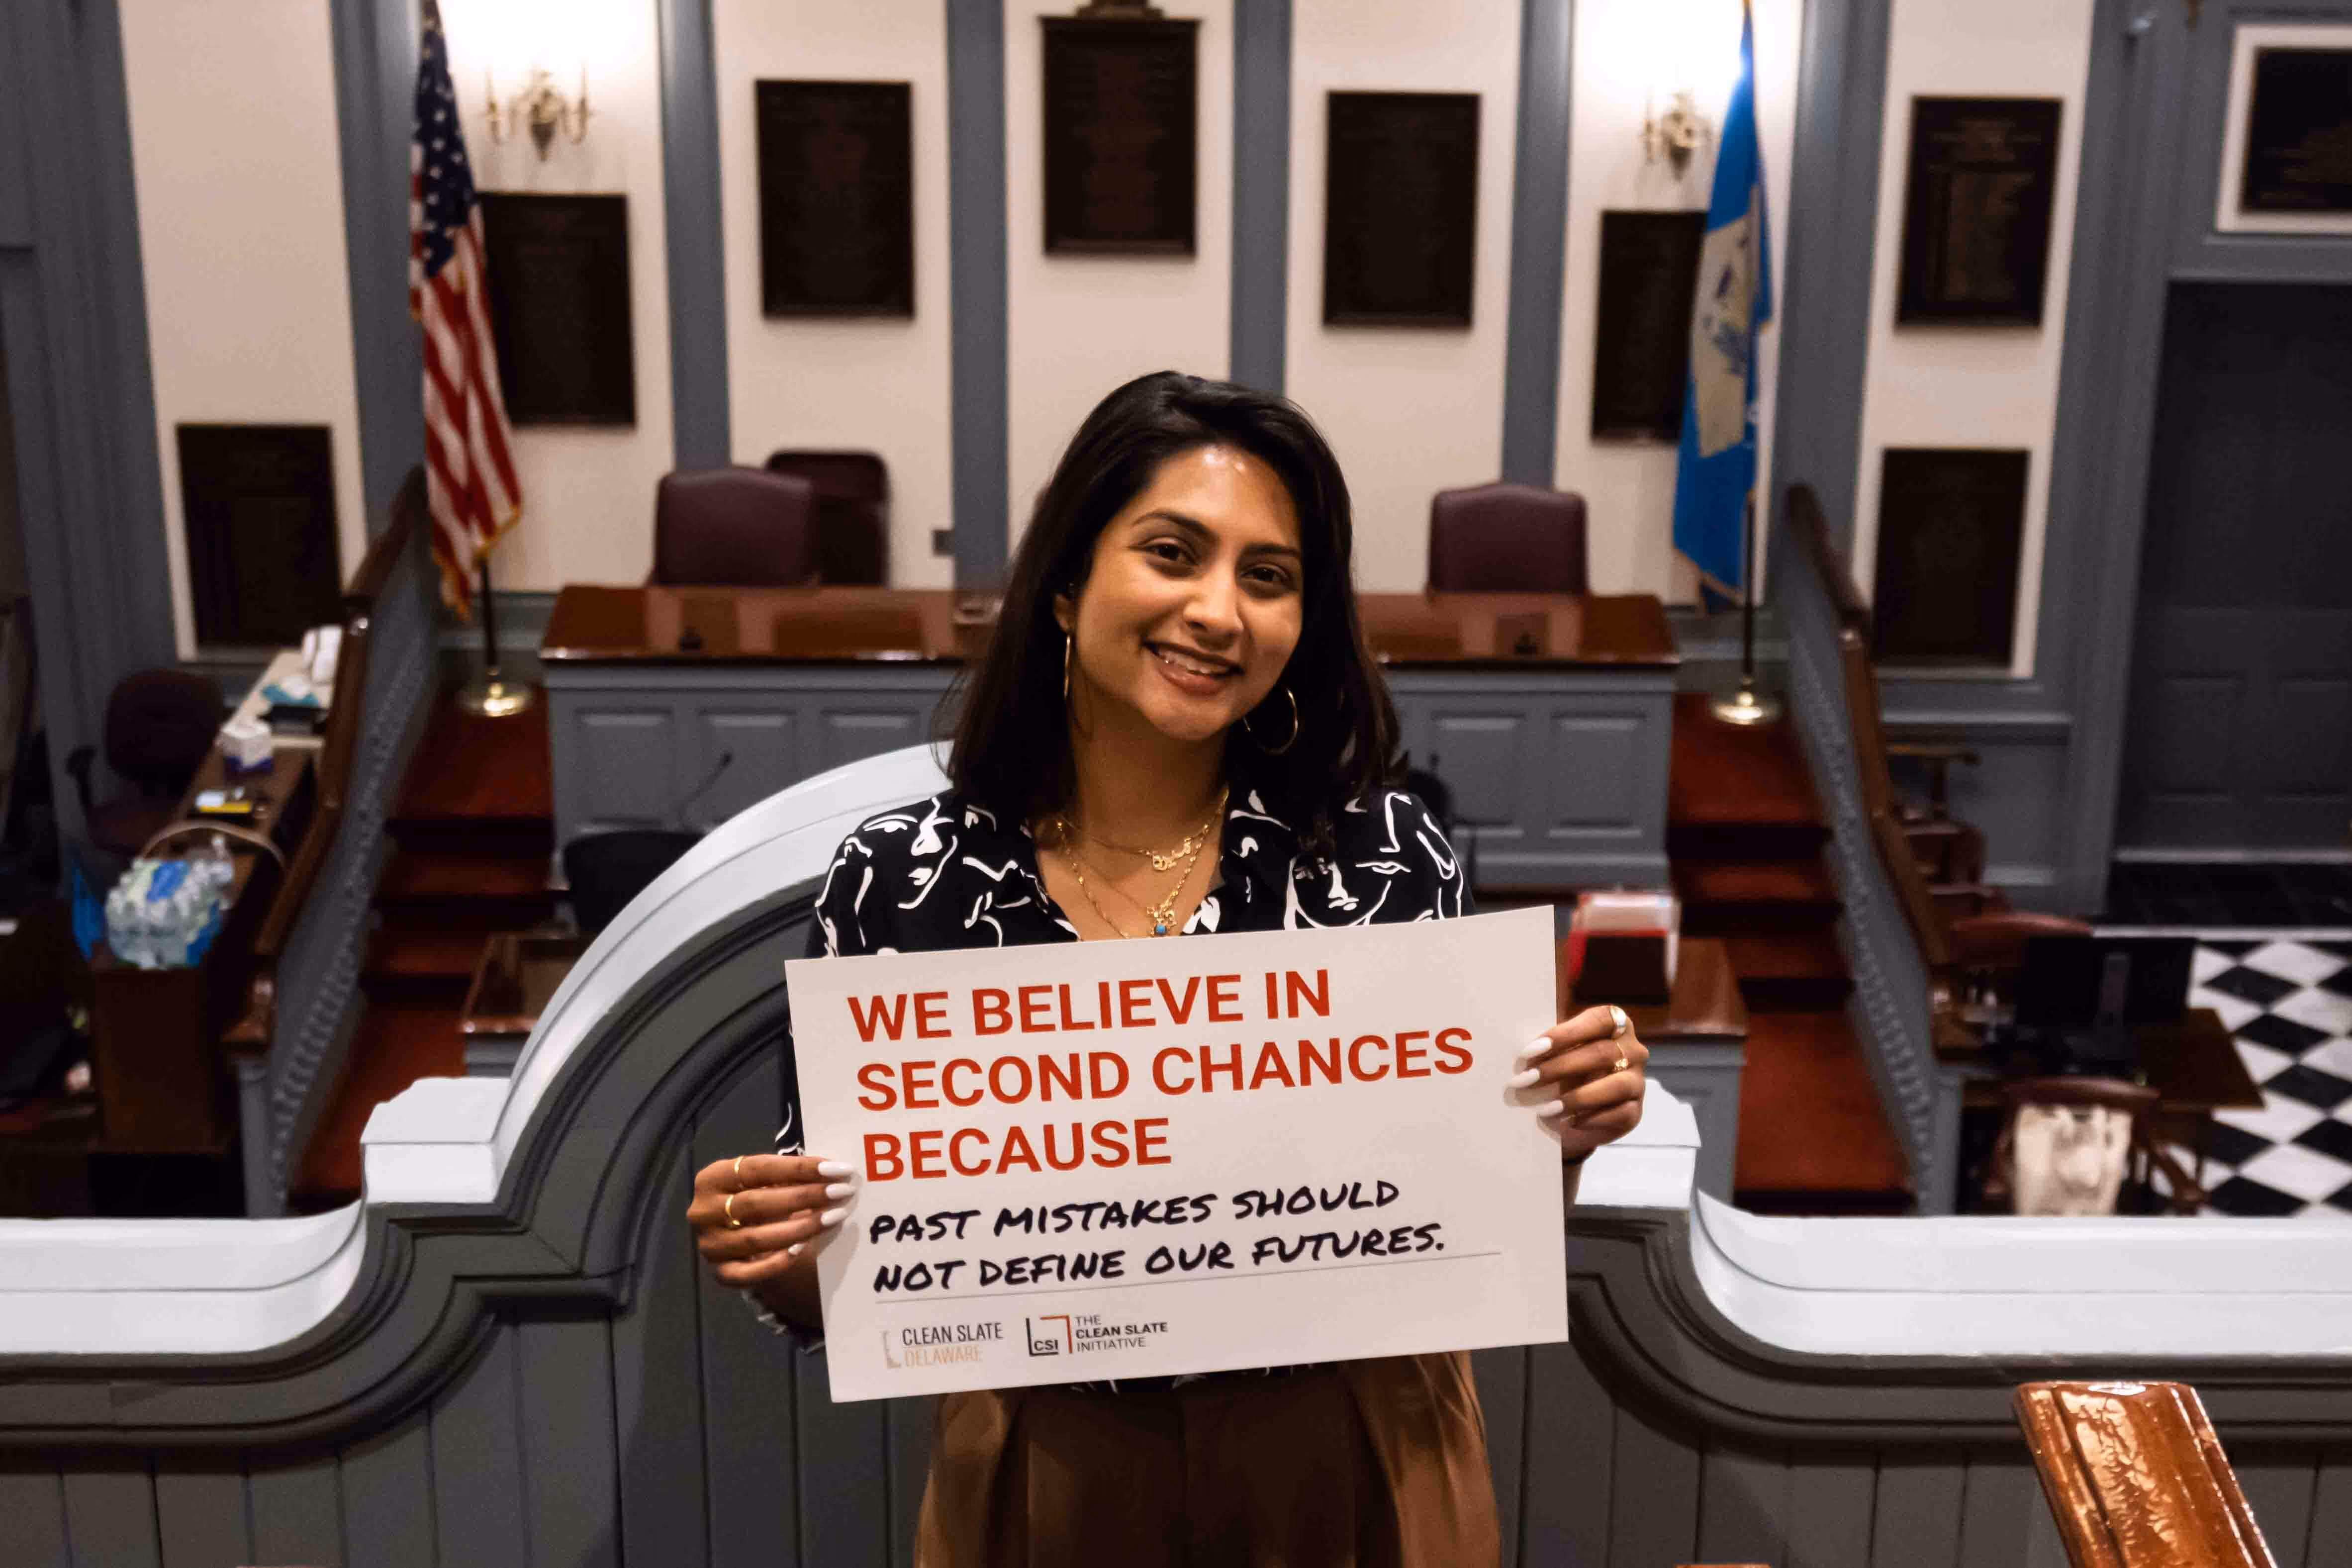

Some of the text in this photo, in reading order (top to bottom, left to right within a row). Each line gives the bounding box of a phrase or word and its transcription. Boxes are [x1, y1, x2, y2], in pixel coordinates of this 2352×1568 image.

[847, 969, 1329, 1042] WE BELIEVE IN
[858, 1027, 1473, 1111] SECOND CHANCES
[863, 1118, 1170, 1181] BECAUSE
[870, 1181, 1399, 1244] PAST MISTAKES SHOULD
[874, 1223, 1444, 1292] NOT DEFINE OUR FUTURES.
[1075, 1315, 1101, 1326] THE
[1076, 1322, 1168, 1339] CLEAN SLATE
[902, 1322, 1004, 1346] CLEAN SLATE
[1034, 1339, 1058, 1352] CSI
[1077, 1337, 1146, 1351] INITIATIVE
[904, 1347, 982, 1368] DELAWARE
